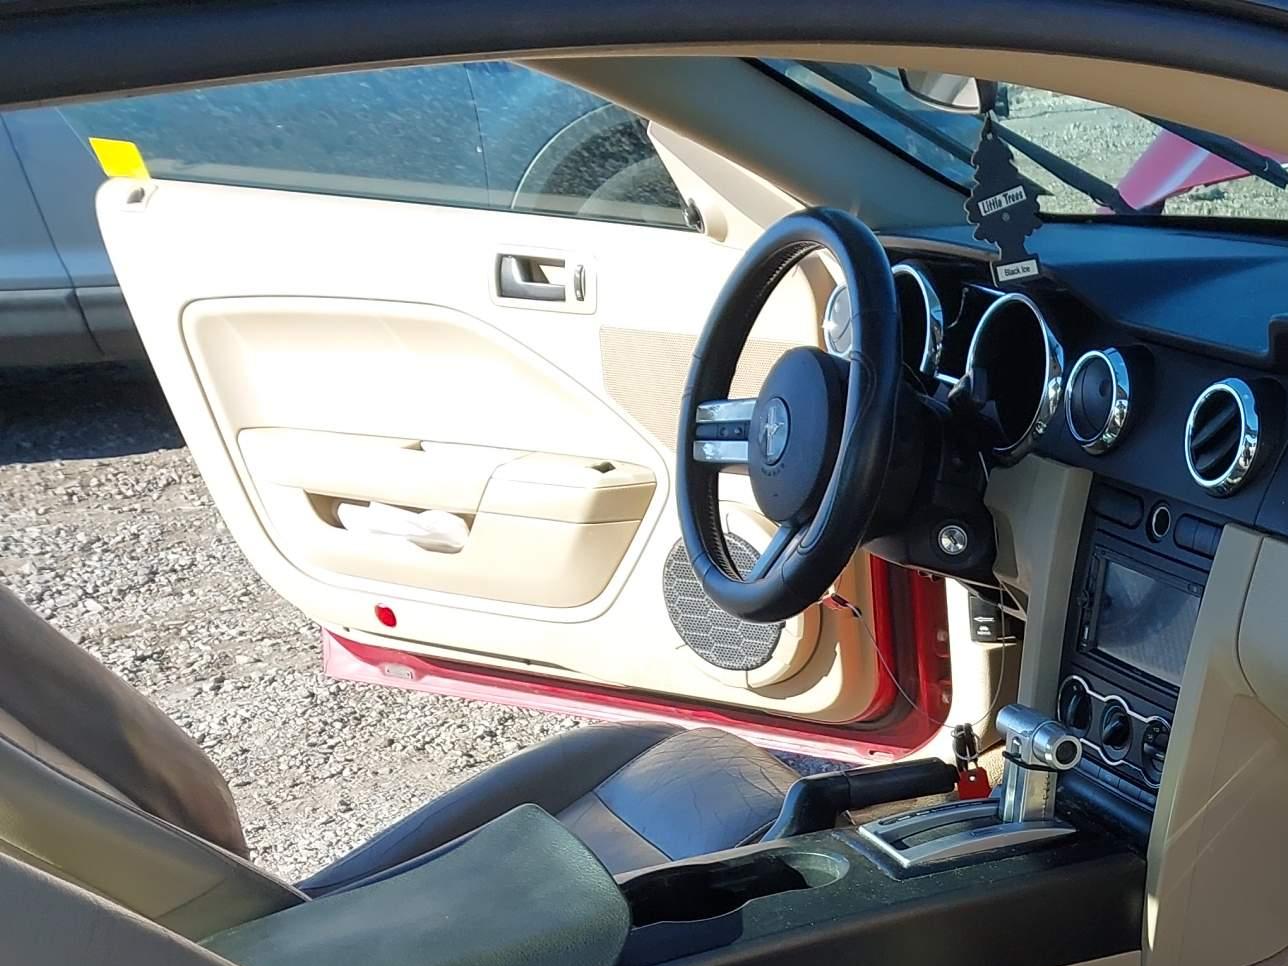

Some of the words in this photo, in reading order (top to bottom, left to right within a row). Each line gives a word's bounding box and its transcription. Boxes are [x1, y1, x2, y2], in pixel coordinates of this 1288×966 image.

[981, 196, 1003, 213] Little
[1002, 190, 1024, 205] Trees
[1004, 267, 1020, 277] Black
[1021, 265, 1031, 274] Ice
